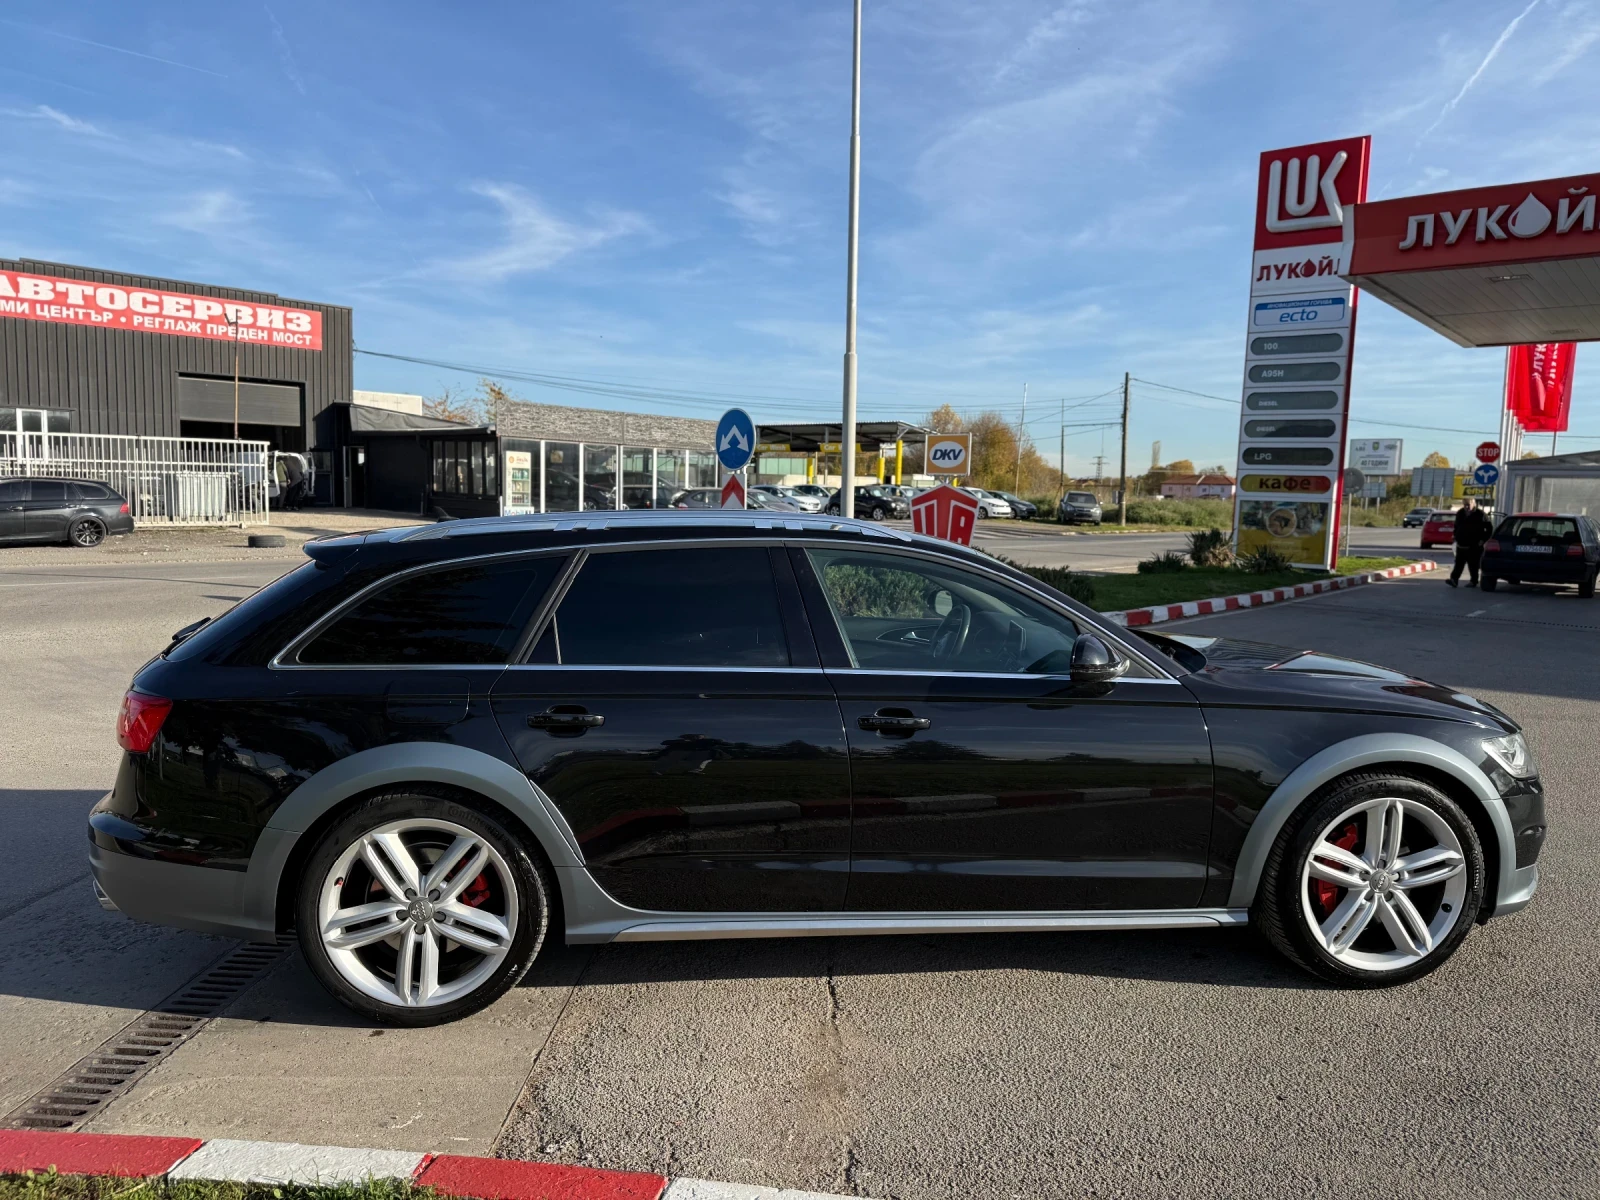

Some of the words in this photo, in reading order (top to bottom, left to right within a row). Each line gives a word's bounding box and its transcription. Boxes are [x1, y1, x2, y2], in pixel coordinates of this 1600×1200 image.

[1397, 186, 1600, 251] ЛУКОЙ
[1279, 308, 1318, 323] ecto
[35, 303, 113, 323] ЦЕНТЪР
[133, 315, 202, 333] РЕГЛАЖ
[207, 323, 268, 340] ПРЕДЕН
[272, 331, 313, 345] МОСТ
[1263, 342, 1278, 350] 100
[931, 448, 963, 461] DKV
[1254, 453, 1272, 461] LPG
[1477, 447, 1500, 457] STOP
[1259, 475, 1312, 492] кафе
